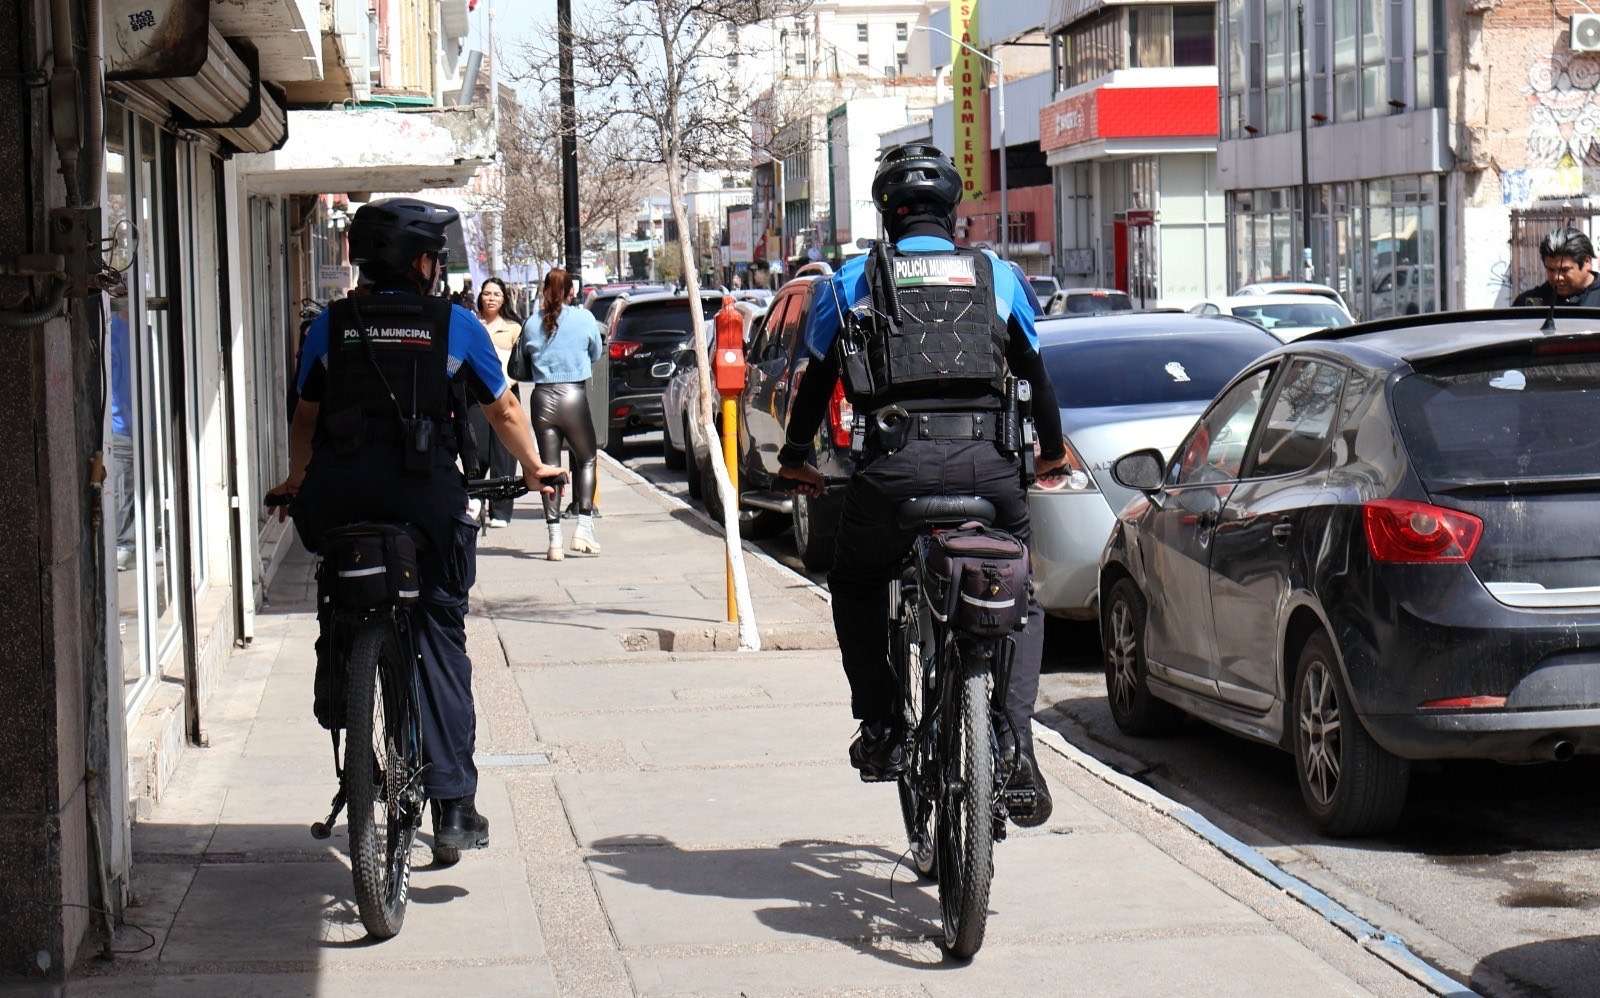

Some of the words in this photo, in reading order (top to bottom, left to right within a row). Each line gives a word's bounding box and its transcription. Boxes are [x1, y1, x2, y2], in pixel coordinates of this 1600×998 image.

[960, 0, 975, 192] STACIONAMIENTO
[896, 258, 928, 278] POLICÍA
[381, 328, 432, 339] MUNICIPAL
